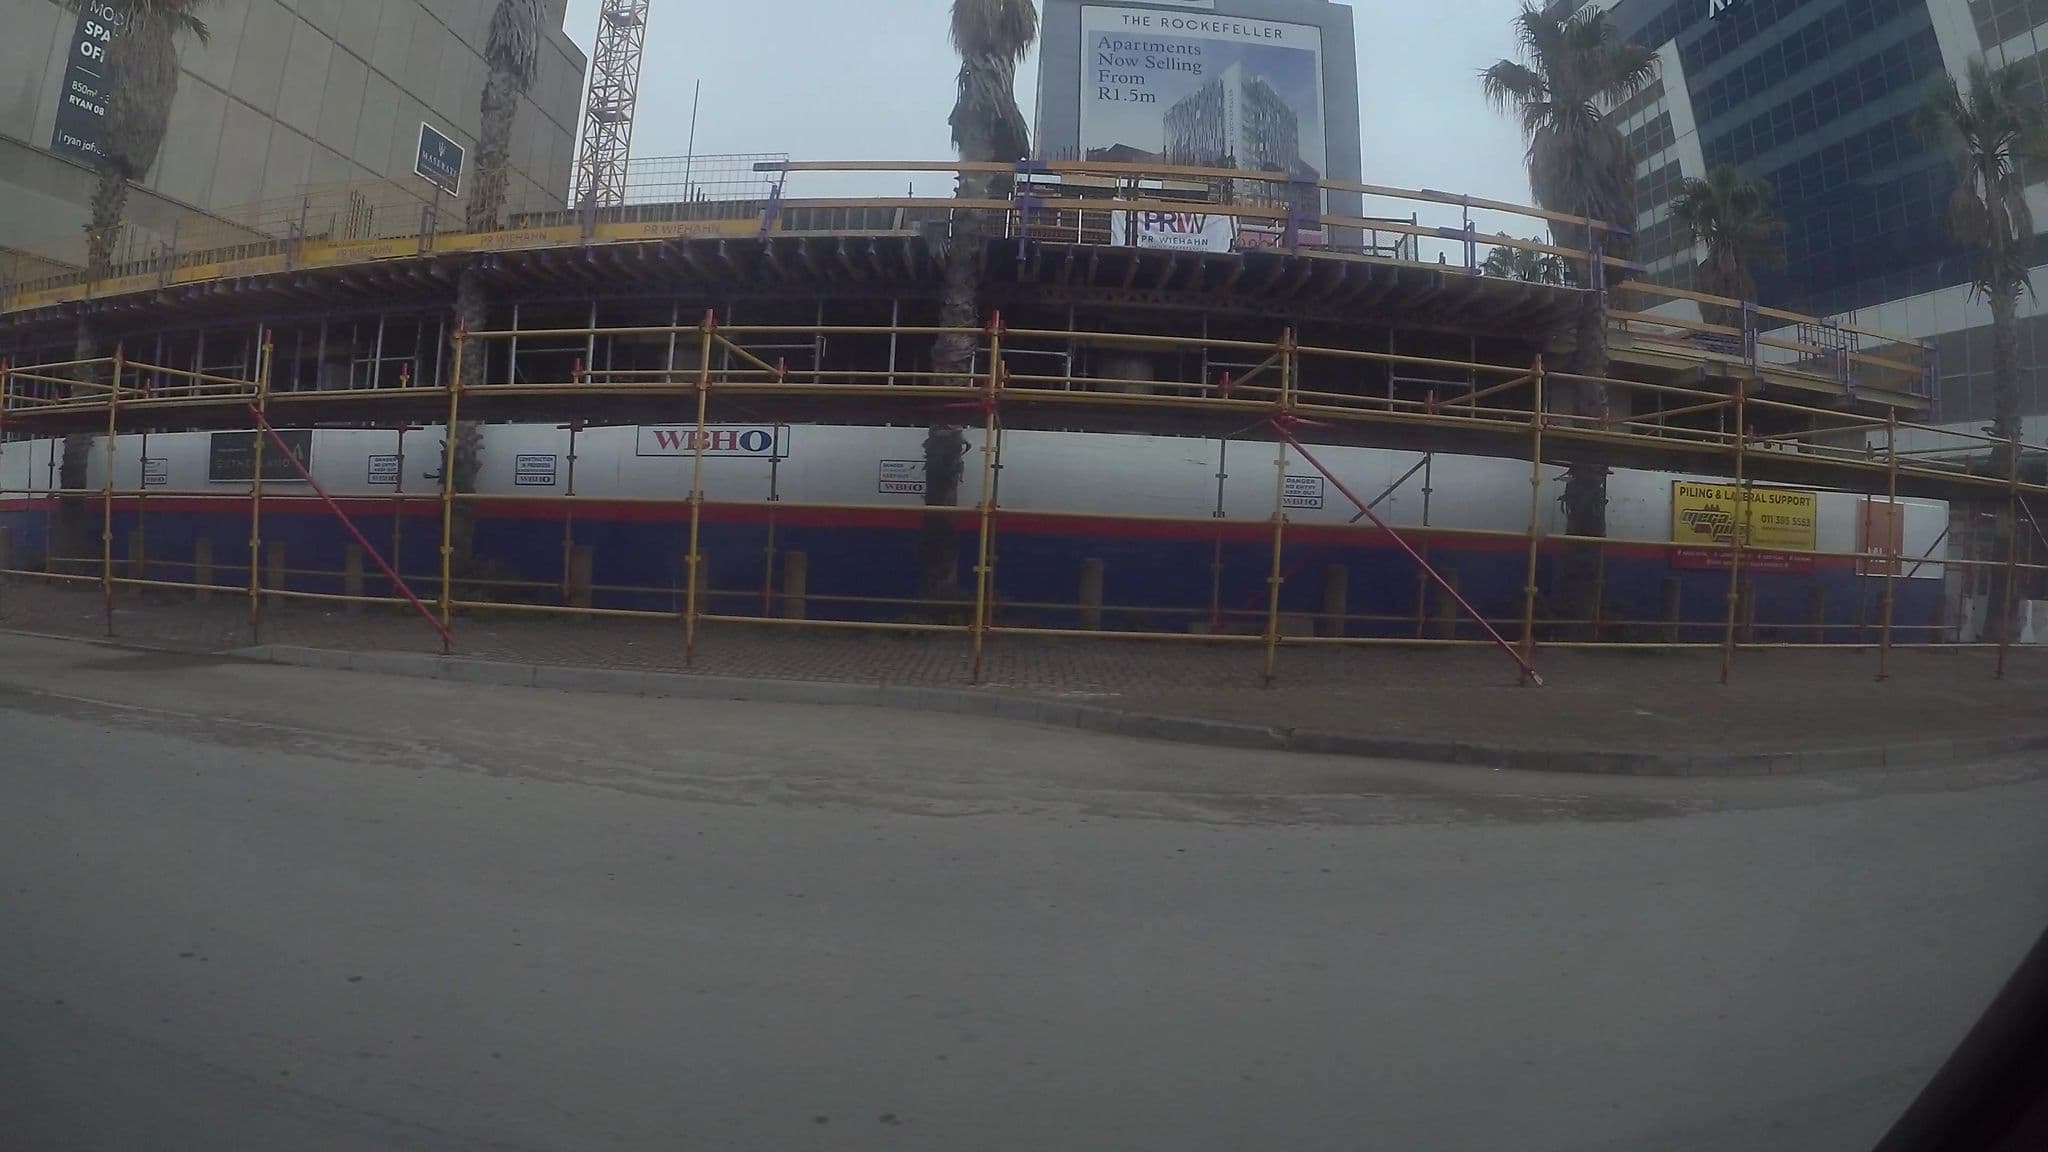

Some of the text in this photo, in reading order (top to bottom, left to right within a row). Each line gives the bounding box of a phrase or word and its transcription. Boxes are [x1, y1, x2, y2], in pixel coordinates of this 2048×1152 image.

[1122, 14, 1282, 39] THE ROCKEFELLER
[1097, 36, 1202, 56] Apartments
[1097, 53, 1203, 75] Now Selling
[1097, 70, 1145, 85] From
[1097, 87, 1156, 103] R1.5m
[69, 94, 93, 112] RYAN
[93, 105, 105, 116] 08
[63, 134, 82, 147] ryan
[643, 222, 721, 234] PR WIEHAHN
[480, 231, 548, 246] PR WIEHAHN
[1141, 235, 1209, 246] PR WIEHAHN
[653, 429, 773, 452] WBHO
[885, 483, 923, 492] WBHO
[1283, 498, 1318, 506] WBHO
[1679, 486, 1713, 500] PILING
[1715, 489, 1722, 500] &
[1769, 494, 1811, 507] SUPPORT
[1761, 514, 1774, 524] 011
